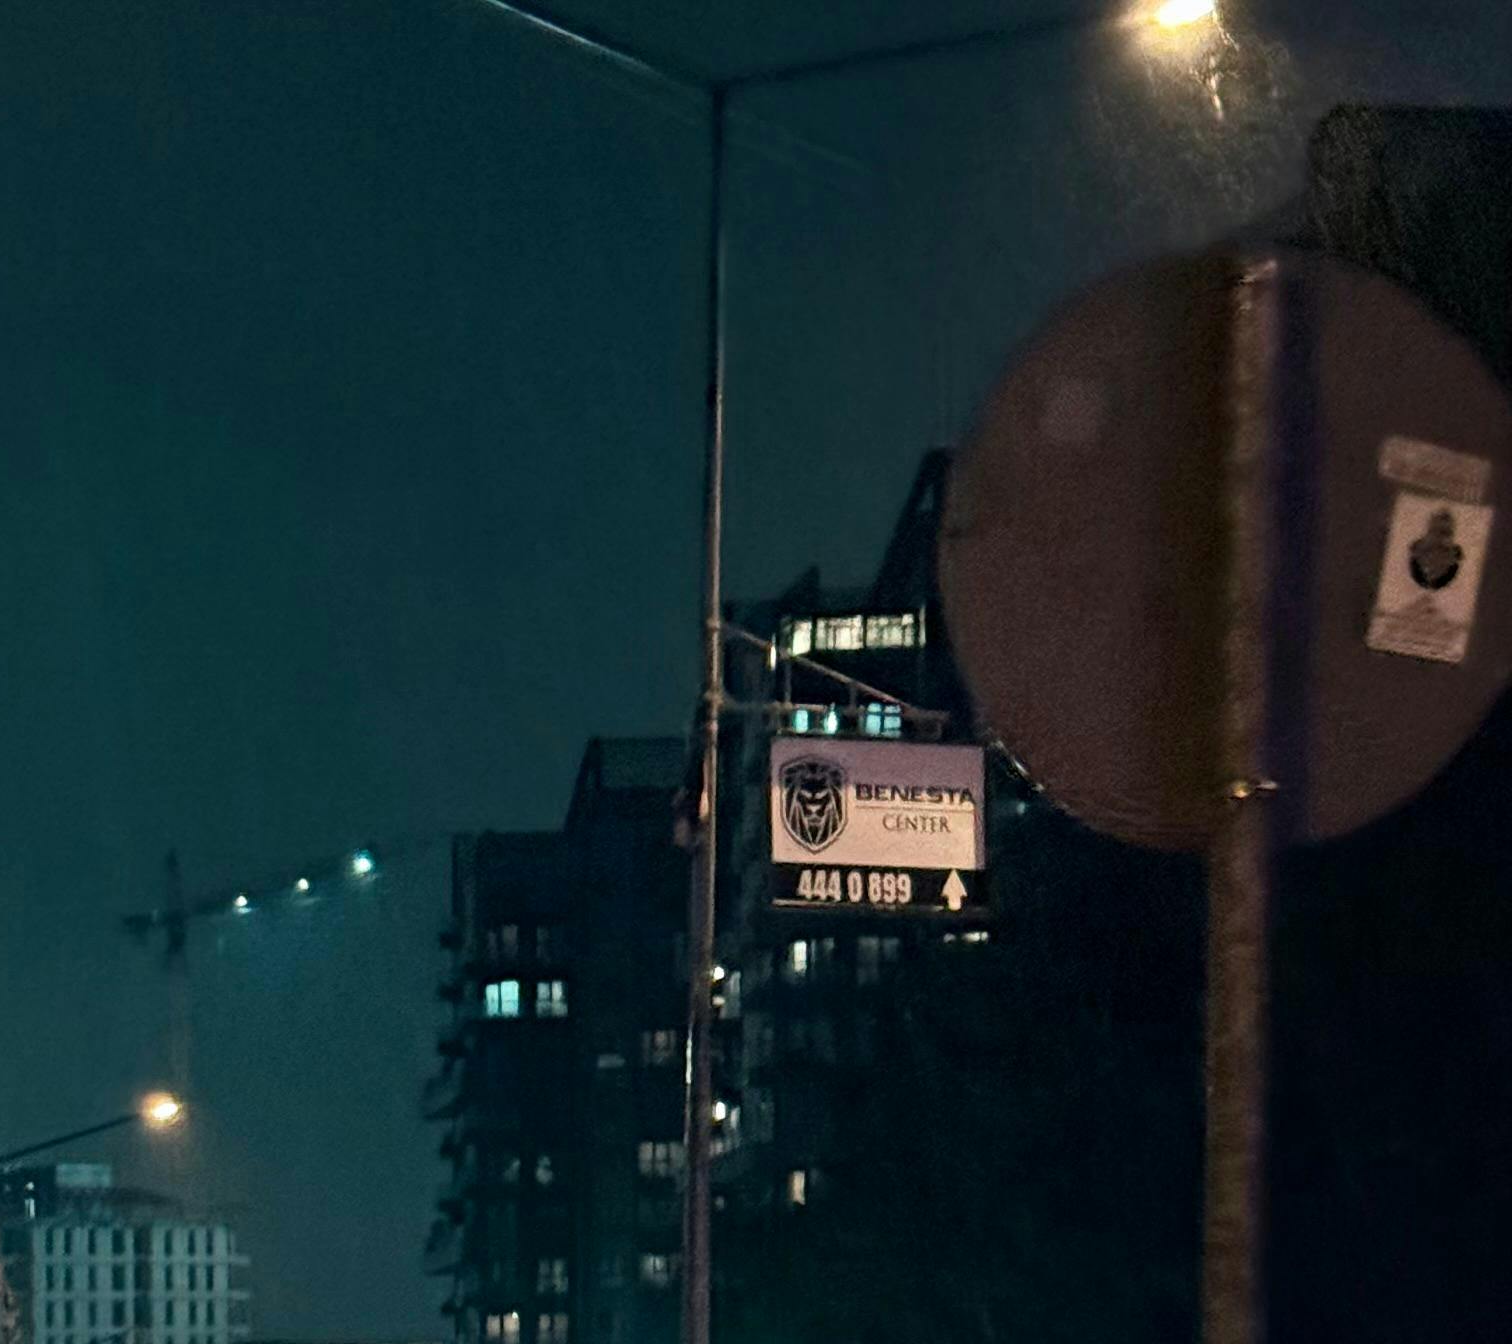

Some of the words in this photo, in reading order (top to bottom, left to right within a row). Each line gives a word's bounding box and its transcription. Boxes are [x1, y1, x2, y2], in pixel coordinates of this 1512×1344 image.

[854, 783, 974, 804] BENESTA
[882, 812, 952, 834] CENTER
[797, 869, 842, 901] 444
[847, 871, 863, 902] 0
[868, 871, 912, 904] 899
